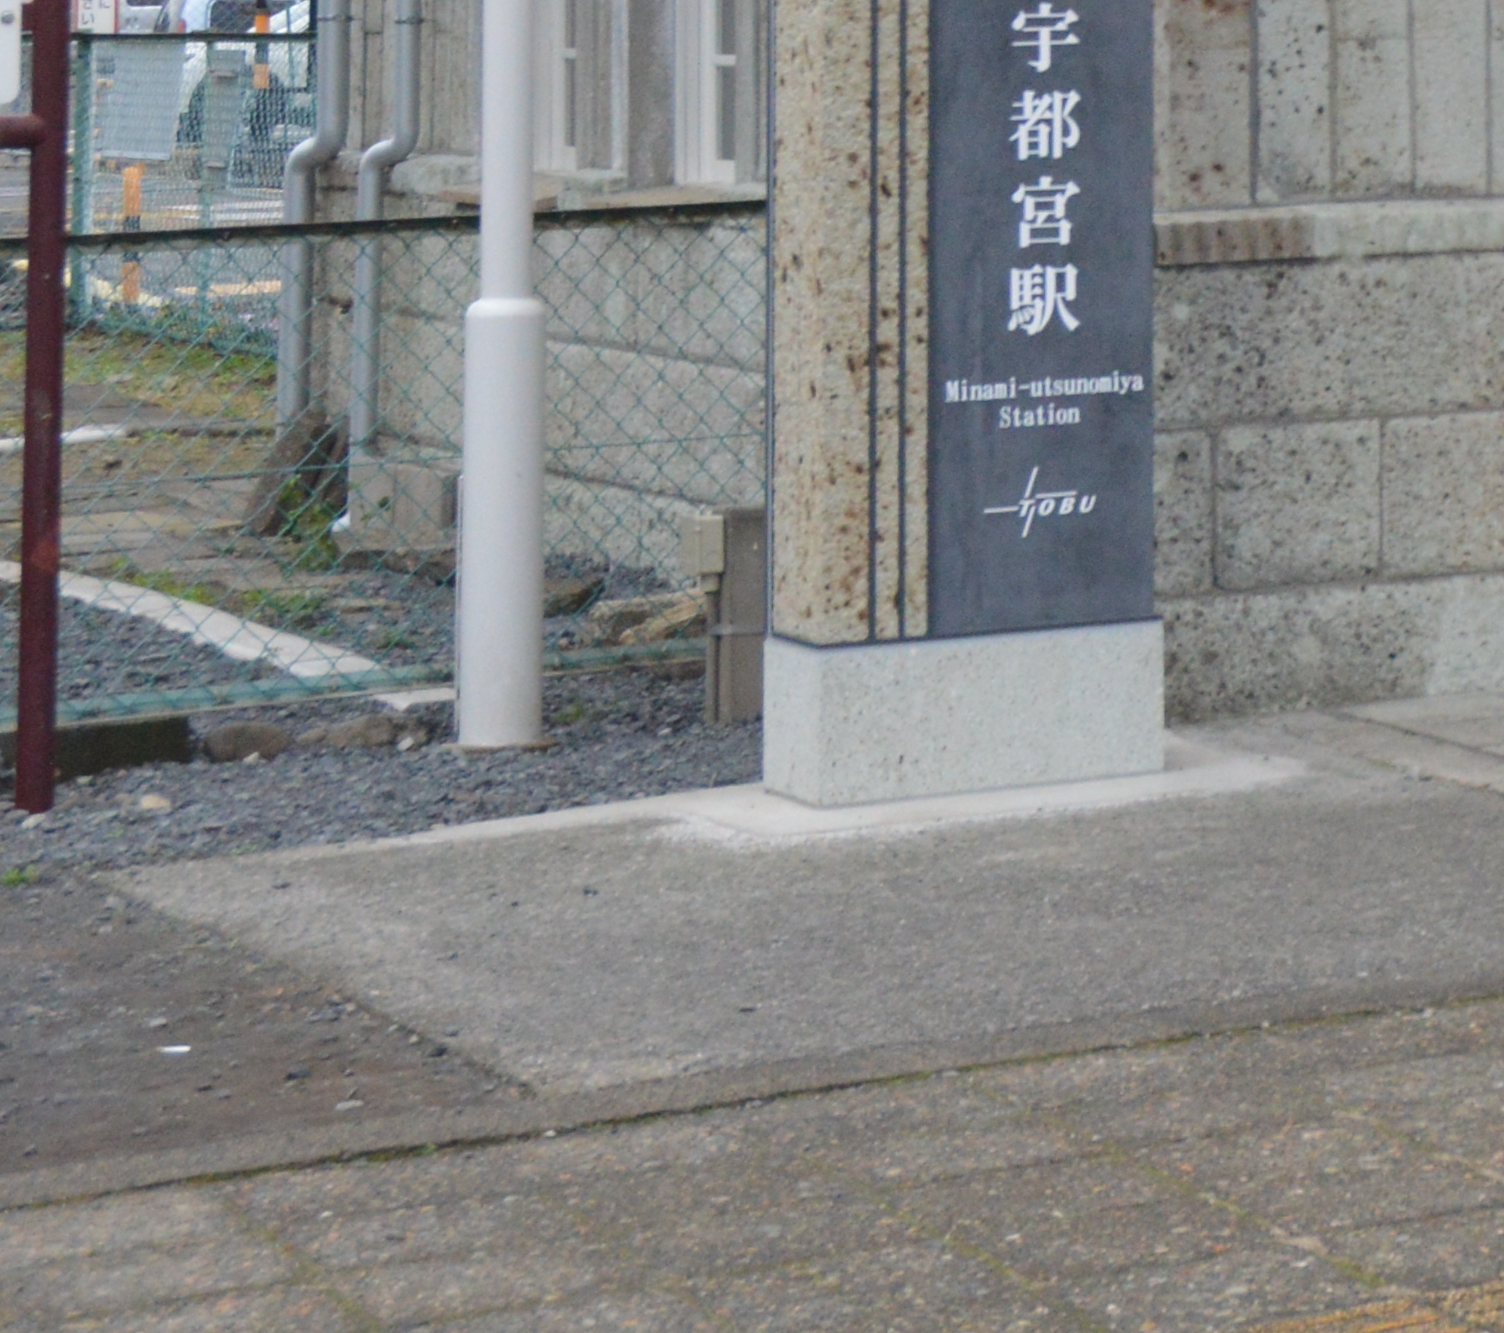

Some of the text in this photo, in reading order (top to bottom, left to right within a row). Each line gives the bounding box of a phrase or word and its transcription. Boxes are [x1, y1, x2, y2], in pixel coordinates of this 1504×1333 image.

[945, 370, 1145, 403] Minami-utsunomiya
[999, 402, 1081, 429] Station
[1018, 494, 1097, 517] TOBU
